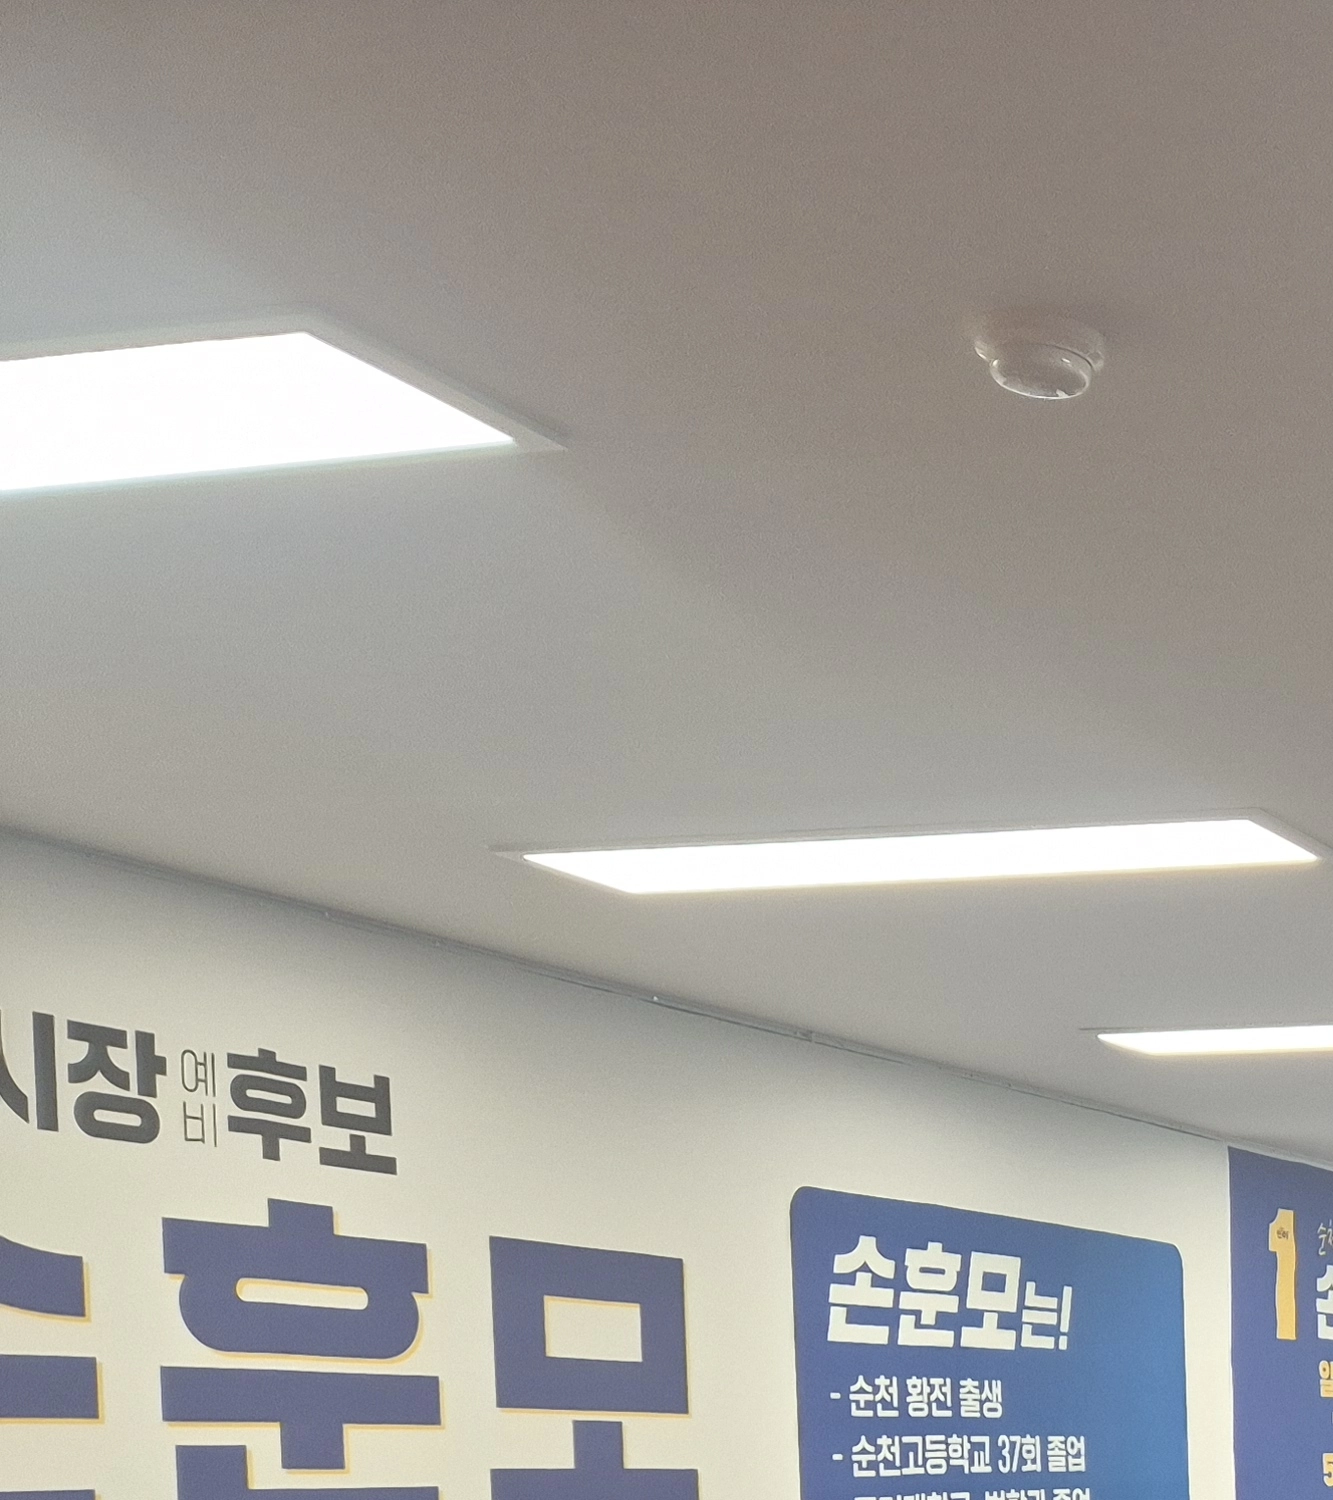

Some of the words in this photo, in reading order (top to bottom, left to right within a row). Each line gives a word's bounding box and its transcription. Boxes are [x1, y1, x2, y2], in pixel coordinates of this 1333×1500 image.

[227, 1047, 398, 1175] 후보
[827, 1234, 1073, 1351] 손훈모는!
[1268, 1207, 1297, 1340] 1
[849, 1375, 899, 1418] 순천
[906, 1376, 953, 1418] 황전
[959, 1378, 1003, 1419] 출생
[851, 1434, 993, 1478] 순천고등학교
[997, 1434, 1042, 1474] 37회
[1047, 1435, 1086, 1473] 졸업
